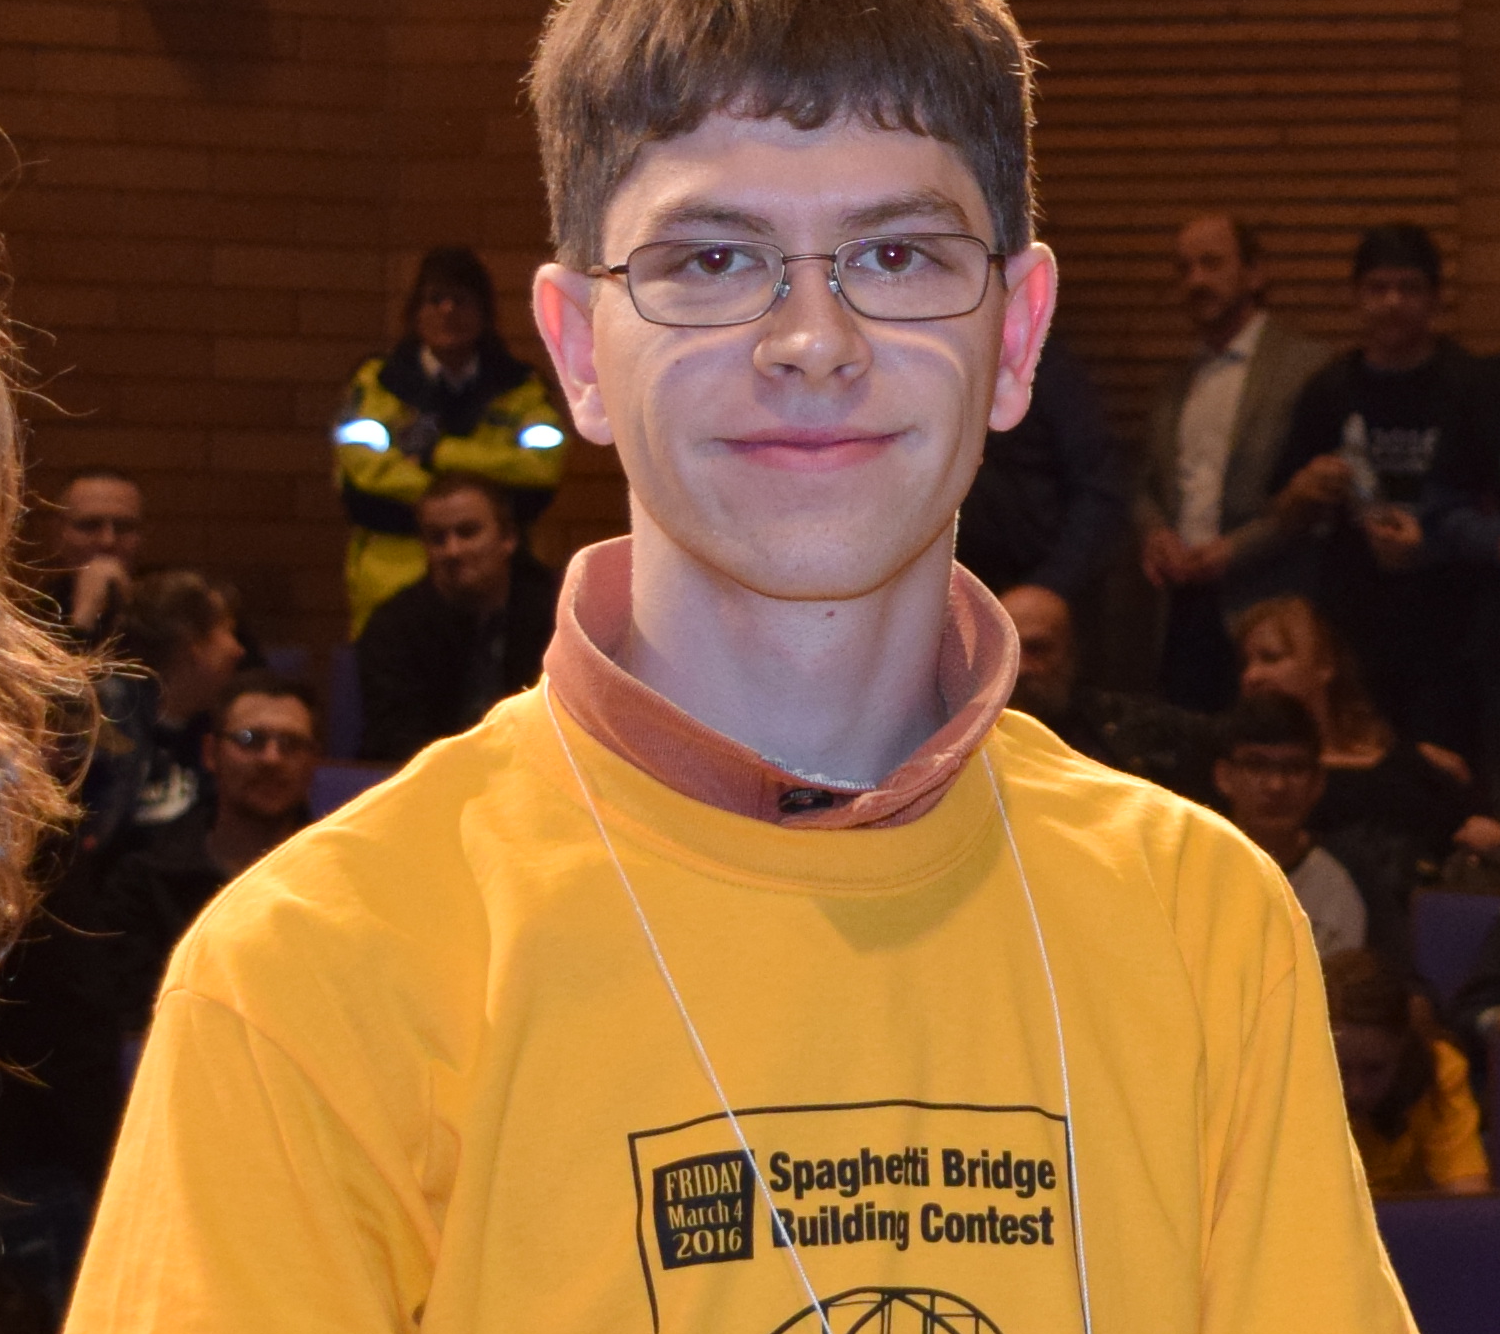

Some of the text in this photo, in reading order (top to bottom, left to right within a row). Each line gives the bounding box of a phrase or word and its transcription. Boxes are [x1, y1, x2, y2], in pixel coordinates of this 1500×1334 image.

[664, 1160, 743, 1201] FRIDAY
[769, 1146, 1057, 1200] Spaghetti Bridge
[667, 1198, 743, 1229] March 4
[772, 1201, 1055, 1251] Building Contest
[672, 1227, 743, 1260] 2016
